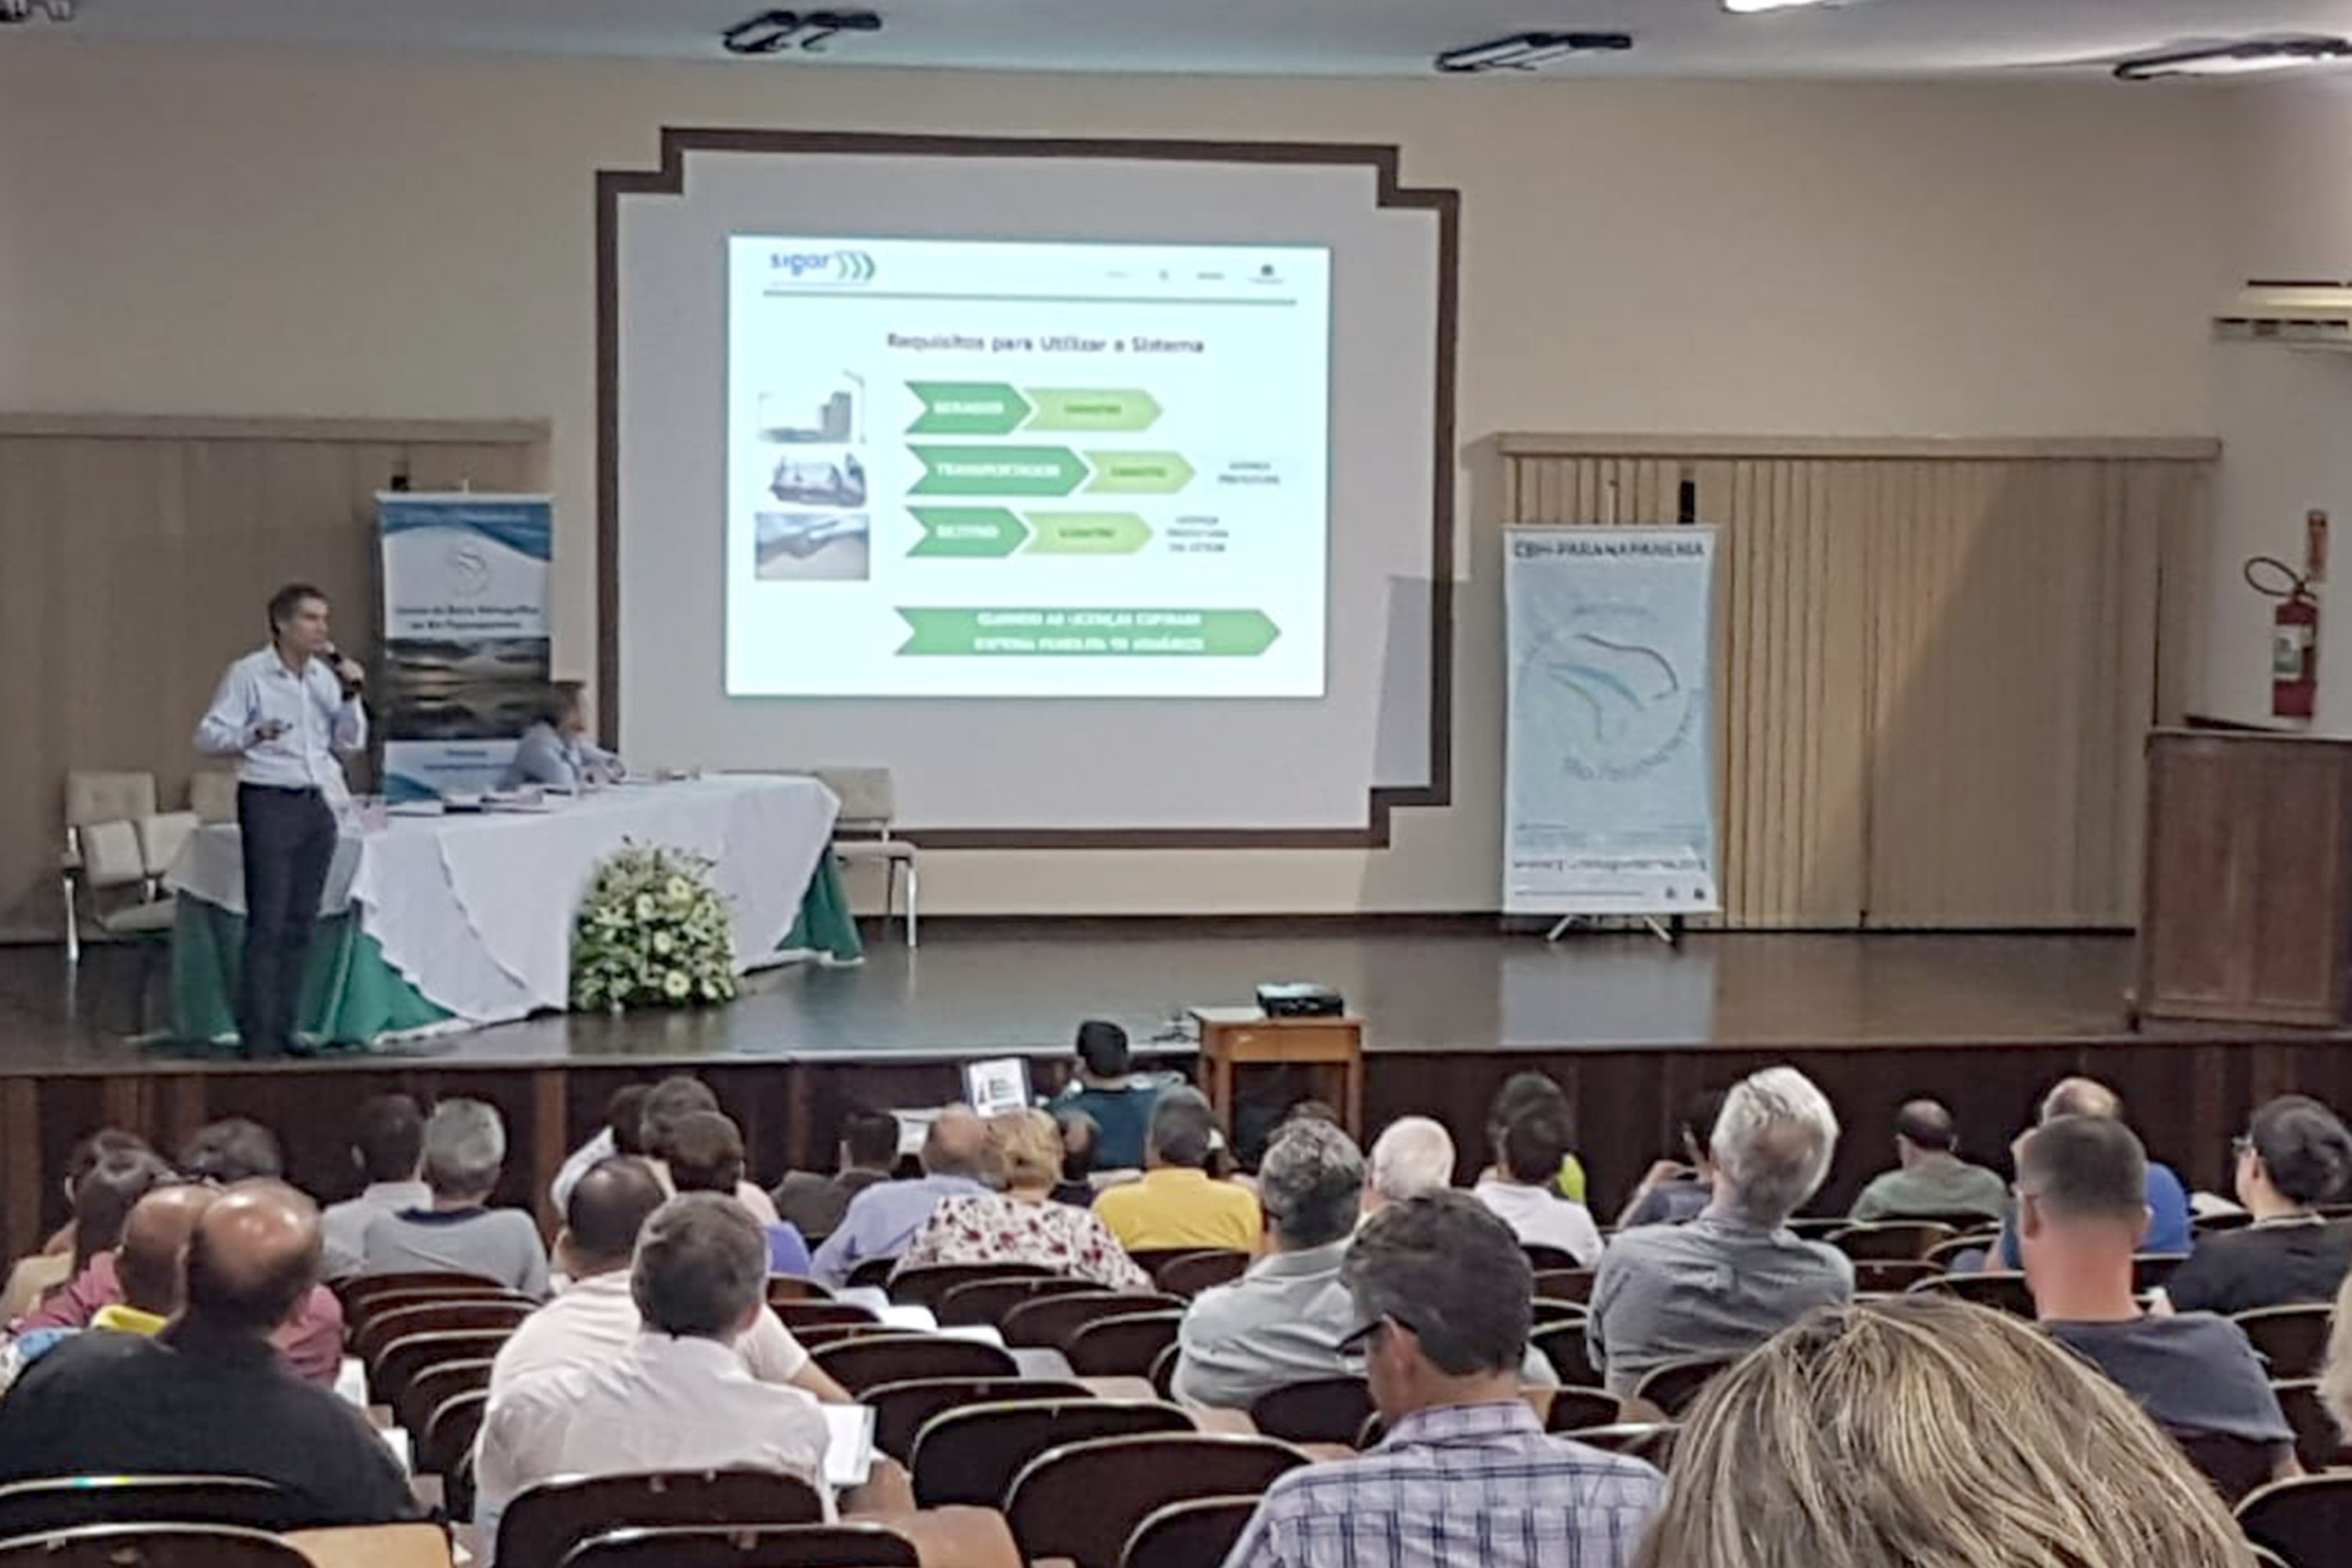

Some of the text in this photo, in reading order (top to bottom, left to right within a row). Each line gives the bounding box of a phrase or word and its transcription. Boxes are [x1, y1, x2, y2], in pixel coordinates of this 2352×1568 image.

[887, 333, 985, 351] Requisitos
[991, 337, 1033, 354] para
[1040, 336, 1107, 352] Utilizar
[1131, 336, 1206, 354] Sistema
